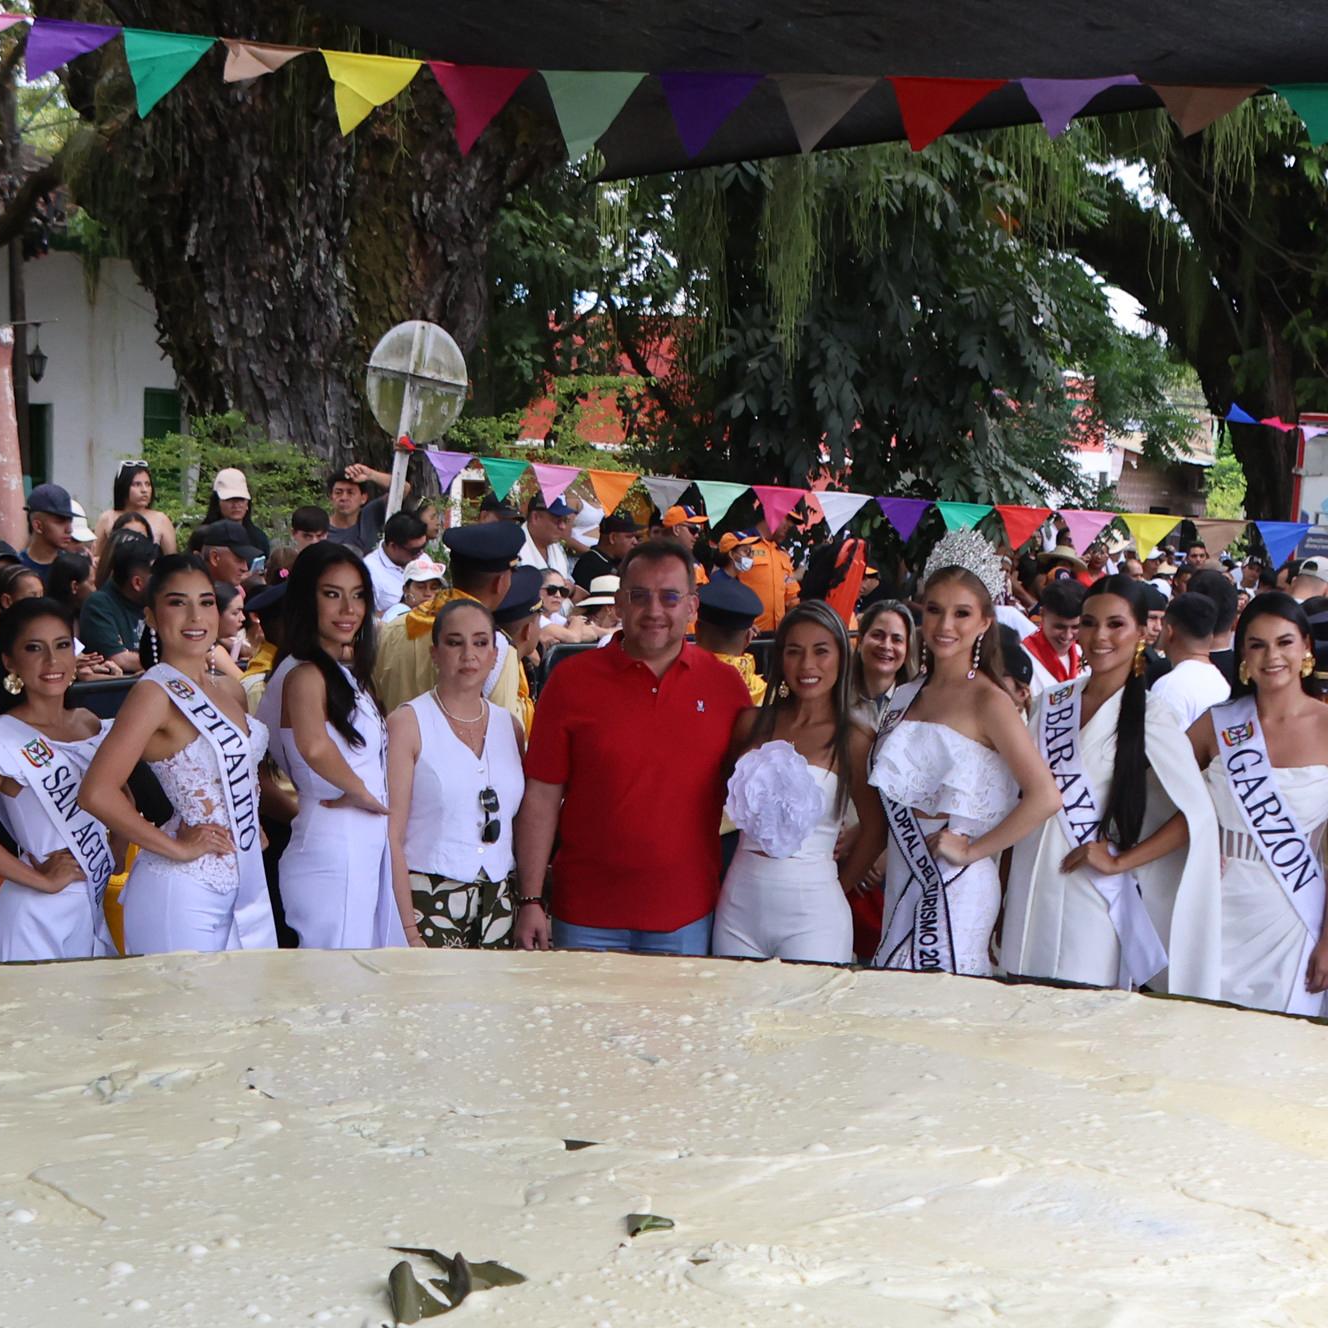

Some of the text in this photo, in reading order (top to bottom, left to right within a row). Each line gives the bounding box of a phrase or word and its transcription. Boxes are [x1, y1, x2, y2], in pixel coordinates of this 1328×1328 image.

[41, 765, 82, 823] SAN
[189, 700, 257, 852] PITALITO
[1045, 702, 1102, 845] BARAYA
[1227, 748, 1319, 893] GARZON
[919, 856, 938, 884] DEL
[919, 880, 940, 946] TURISMO
